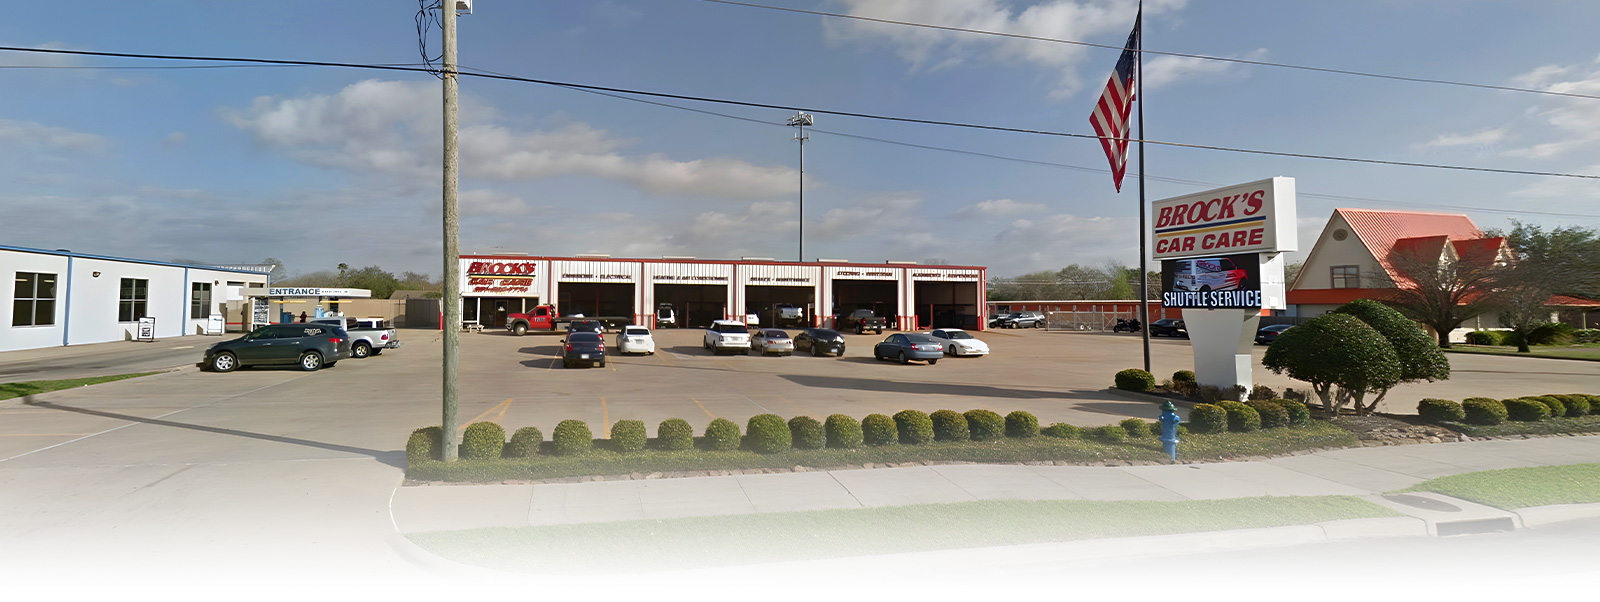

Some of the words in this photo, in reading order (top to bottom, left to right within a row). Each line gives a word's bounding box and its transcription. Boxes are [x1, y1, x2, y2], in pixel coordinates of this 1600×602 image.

[1155, 190, 1265, 229] BROCK'S
[1156, 236, 1196, 254] CAR
[1201, 228, 1265, 250] CARE
[466, 262, 536, 274] BROCK'S
[1163, 291, 1208, 307] SHUTTLE
[1210, 290, 1261, 307] SERVICE
